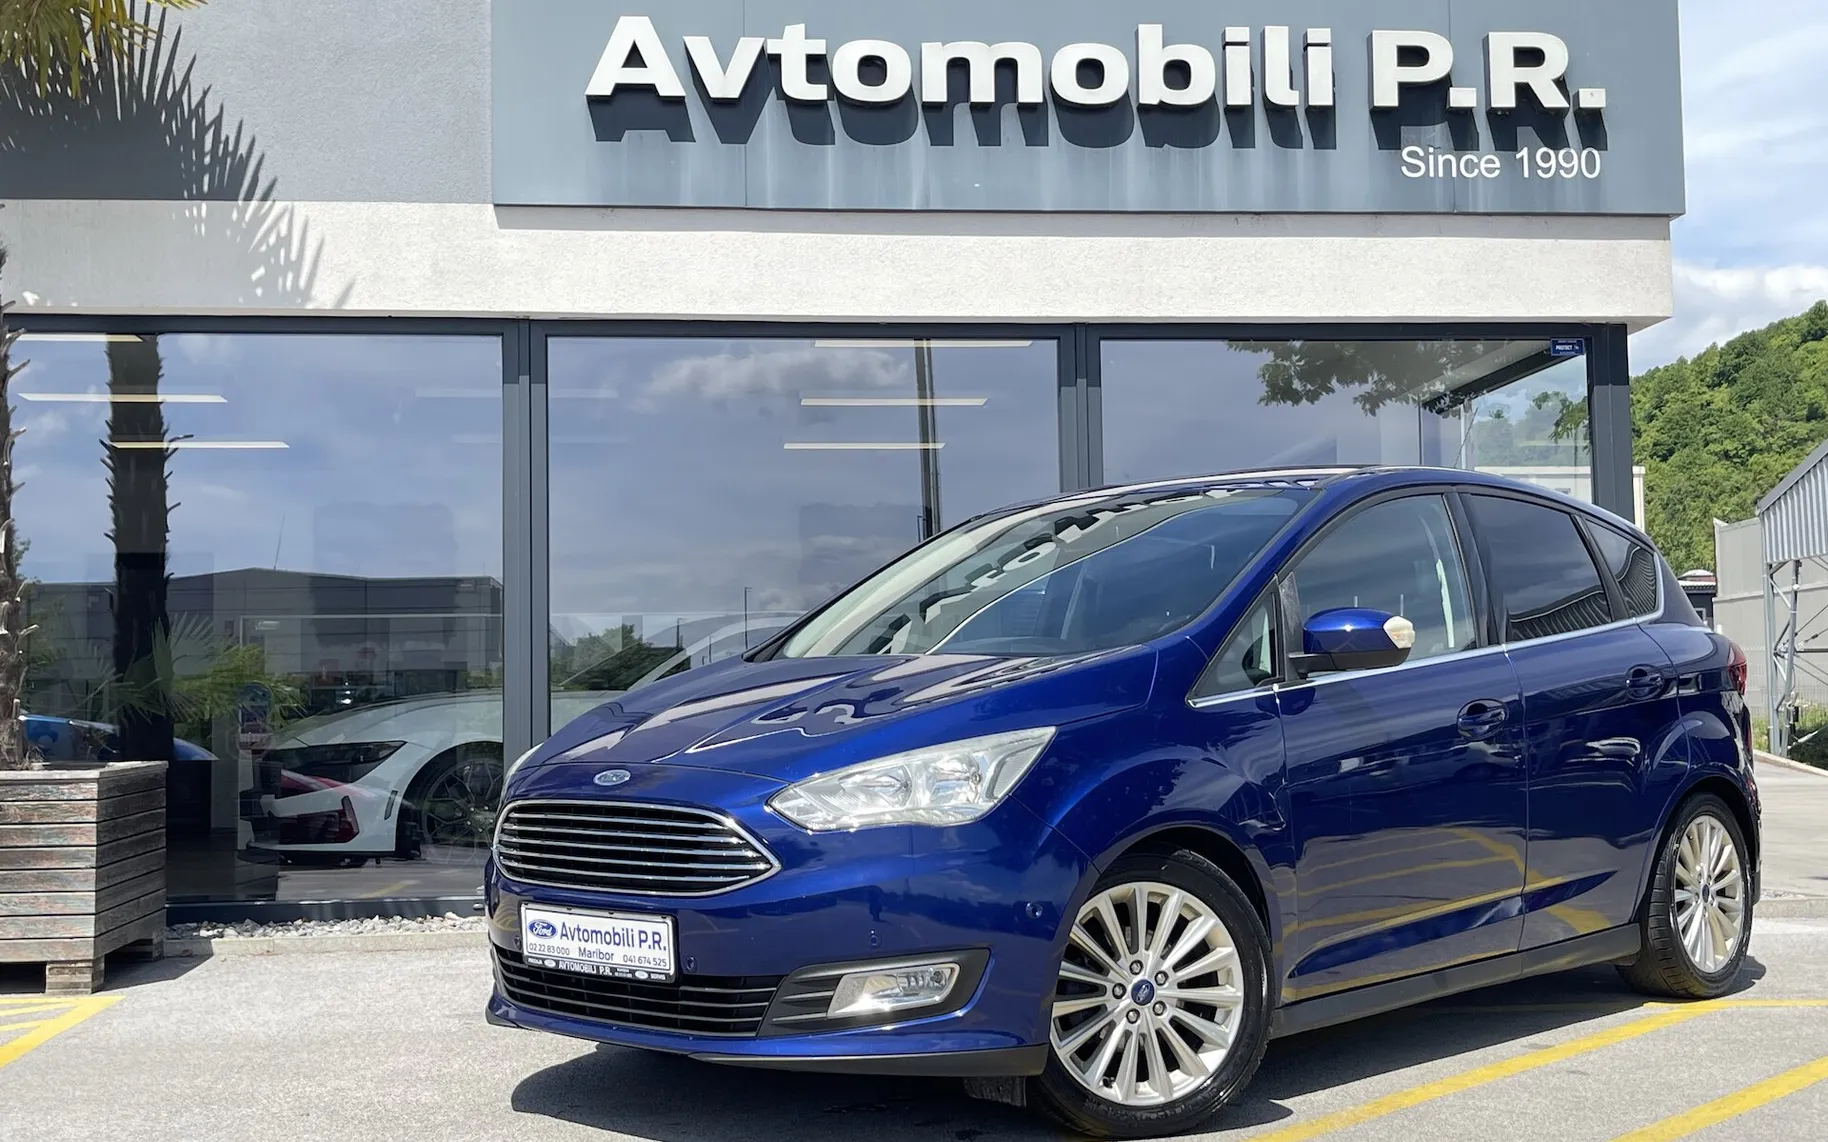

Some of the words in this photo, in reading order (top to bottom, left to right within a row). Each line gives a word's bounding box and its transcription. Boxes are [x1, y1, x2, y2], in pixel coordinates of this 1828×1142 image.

[585, 15, 1333, 109] Avtomobili
[1368, 30, 1607, 110] P.R.
[1401, 146, 1500, 179] Since
[1514, 147, 1601, 179] 1990
[533, 921, 553, 937] Ford
[560, 922, 634, 947] Avtomobili
[638, 930, 667, 951] P.R.
[578, 946, 614, 961] Maribor
[622, 954, 636, 964] 041
[637, 956, 651, 965] 674
[652, 957, 667, 967] 525
